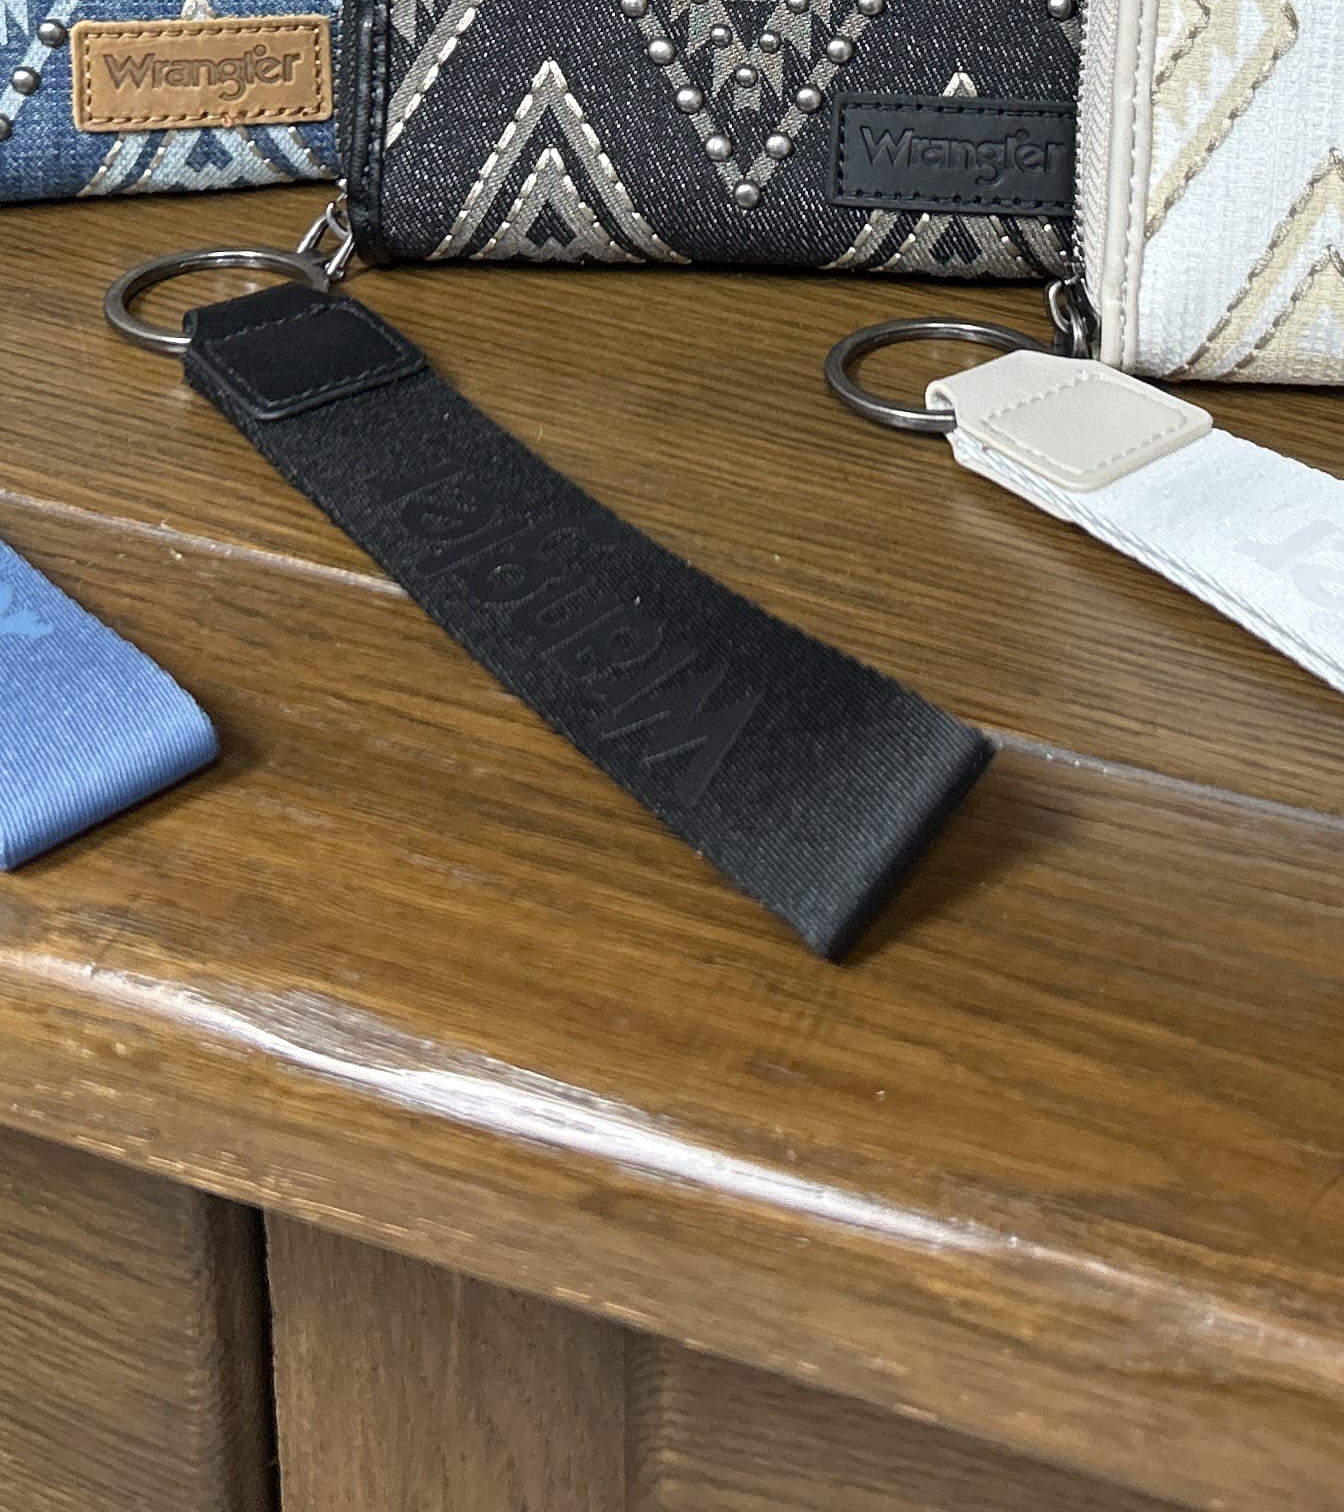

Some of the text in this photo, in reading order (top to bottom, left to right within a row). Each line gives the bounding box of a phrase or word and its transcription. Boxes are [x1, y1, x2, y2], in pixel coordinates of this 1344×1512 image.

[102, 48, 301, 101] Wrangler
[859, 125, 1066, 187] Wrangler
[363, 460, 763, 805] Wrangler
